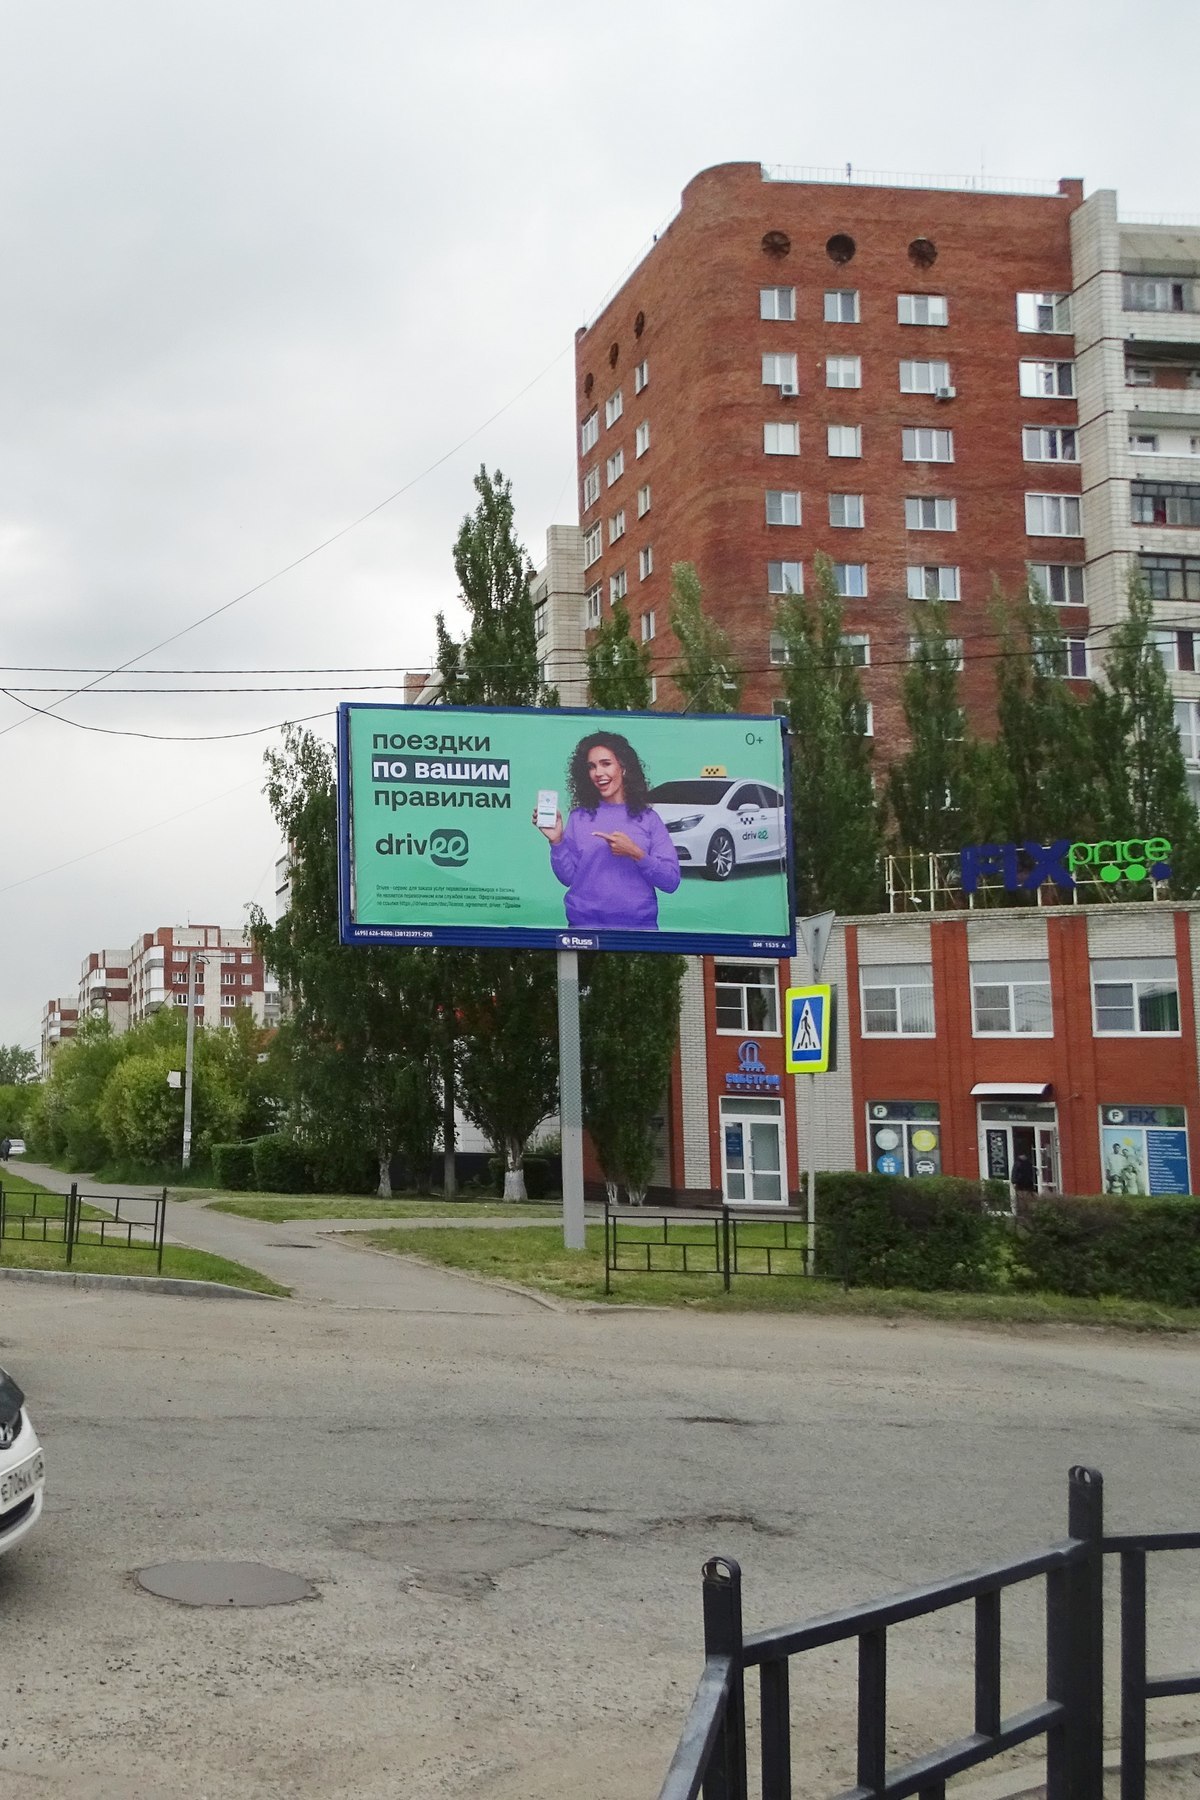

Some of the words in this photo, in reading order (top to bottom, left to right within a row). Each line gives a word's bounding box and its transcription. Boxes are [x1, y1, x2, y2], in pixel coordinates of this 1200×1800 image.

[373, 734, 490, 754] поездки
[745, 733, 763, 745] 0+
[373, 761, 407, 778] по
[415, 762, 509, 781] вашим
[374, 790, 511, 811] правилам
[961, 839, 1075, 893] FIX
[1068, 837, 1173, 872] price
[572, 937, 593, 946] Russ
